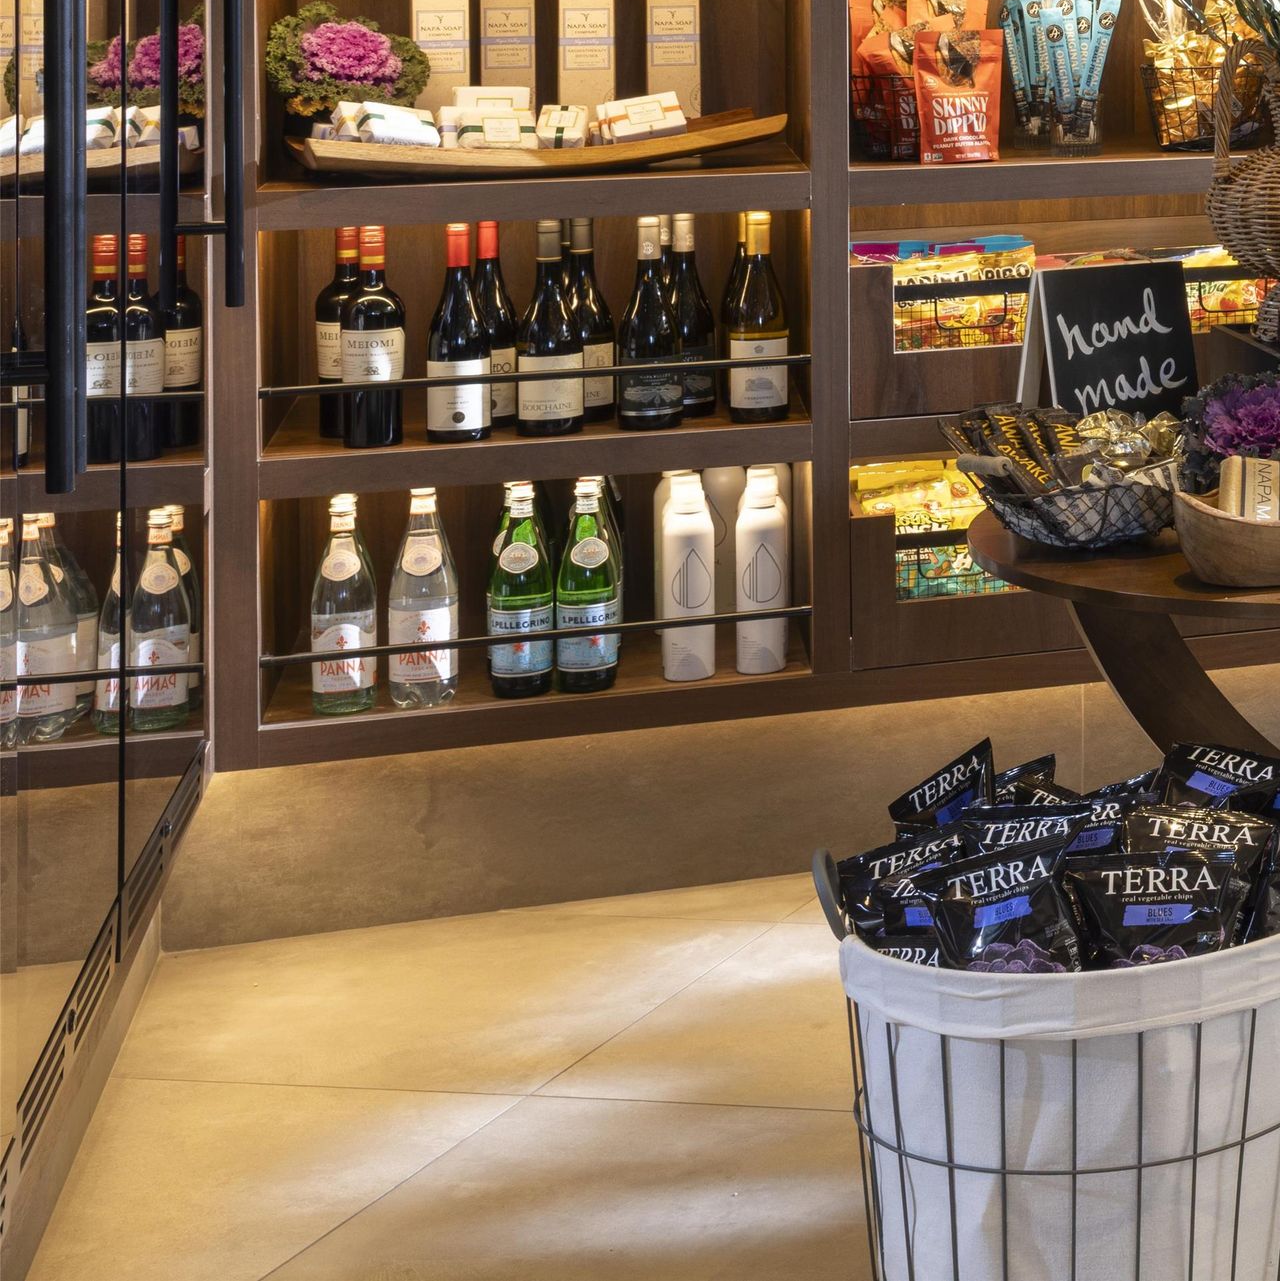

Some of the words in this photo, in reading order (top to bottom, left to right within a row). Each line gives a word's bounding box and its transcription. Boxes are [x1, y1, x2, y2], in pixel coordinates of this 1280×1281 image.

[420, 25, 441, 33] NAPA
[1065, 23, 1079, 71] ORIGINAL
[1056, 50, 1072, 100] ORIGINAL
[1089, 38, 1108, 90] ORIGINAL
[932, 96, 989, 118] SKINNY
[934, 113, 987, 135] DIPPED
[1057, 288, 1172, 360] hand
[347, 339, 394, 349] MEIOMI
[1075, 356, 1188, 417] made
[522, 401, 573, 411] BOUCHAINE
[997, 445, 1050, 484] AWAKE
[320, 660, 366, 676] PANNA
[399, 649, 448, 666] PANNA
[1187, 745, 1274, 782] TERRA
[909, 754, 982, 814] TERRA
[1208, 780, 1230, 793] BLUES
[983, 821, 1071, 844] TERRA
[1077, 832, 1098, 843] BLUES
[1149, 817, 1256, 846] TERRA
[948, 855, 1050, 900] TERRA
[1101, 866, 1217, 895] TERRA
[985, 890, 1013, 902] vegetable
[1013, 885, 1029, 896] chips
[1136, 894, 1172, 903] vegetable
[1174, 893, 1193, 902] chips
[1147, 907, 1173, 918] BLUES
